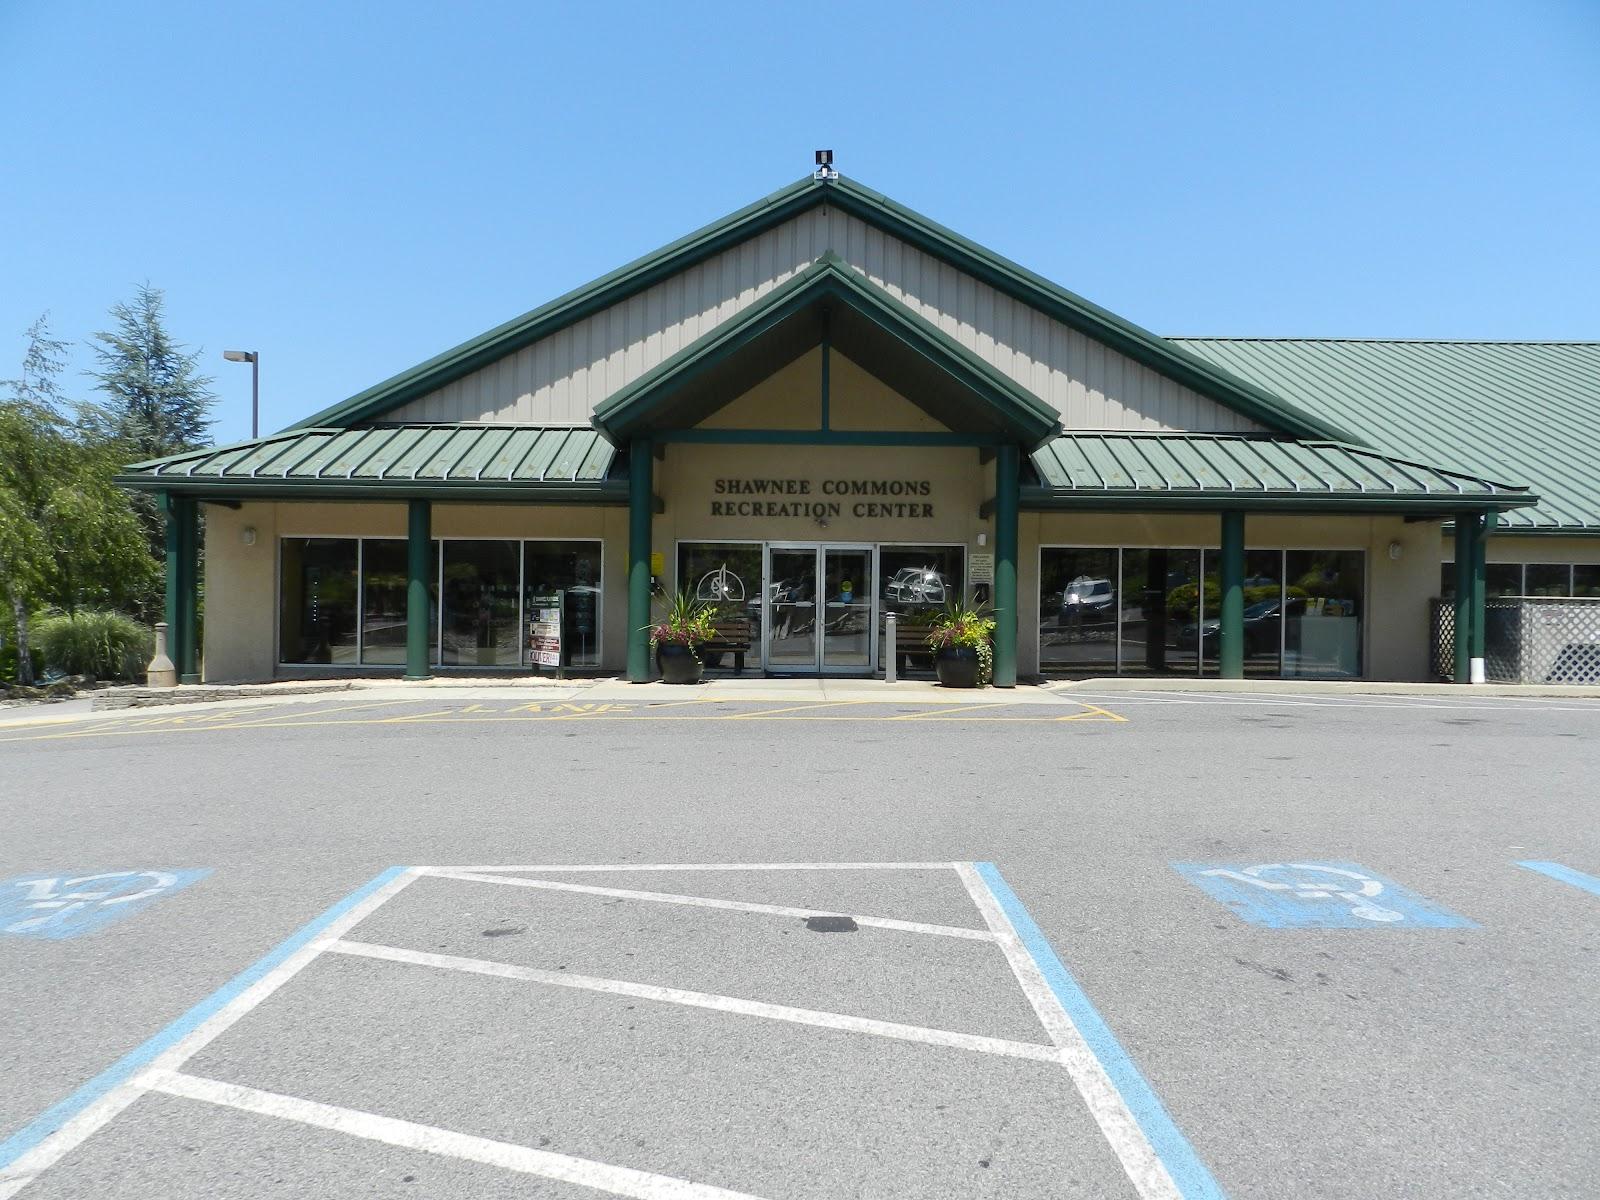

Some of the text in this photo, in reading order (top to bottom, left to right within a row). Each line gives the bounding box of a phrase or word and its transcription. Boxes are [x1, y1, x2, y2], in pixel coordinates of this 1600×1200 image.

[714, 479, 931, 496] SHAWNEE COMMONS
[711, 501, 934, 518] RECREATION CENTER
[459, 703, 639, 713] LANE
